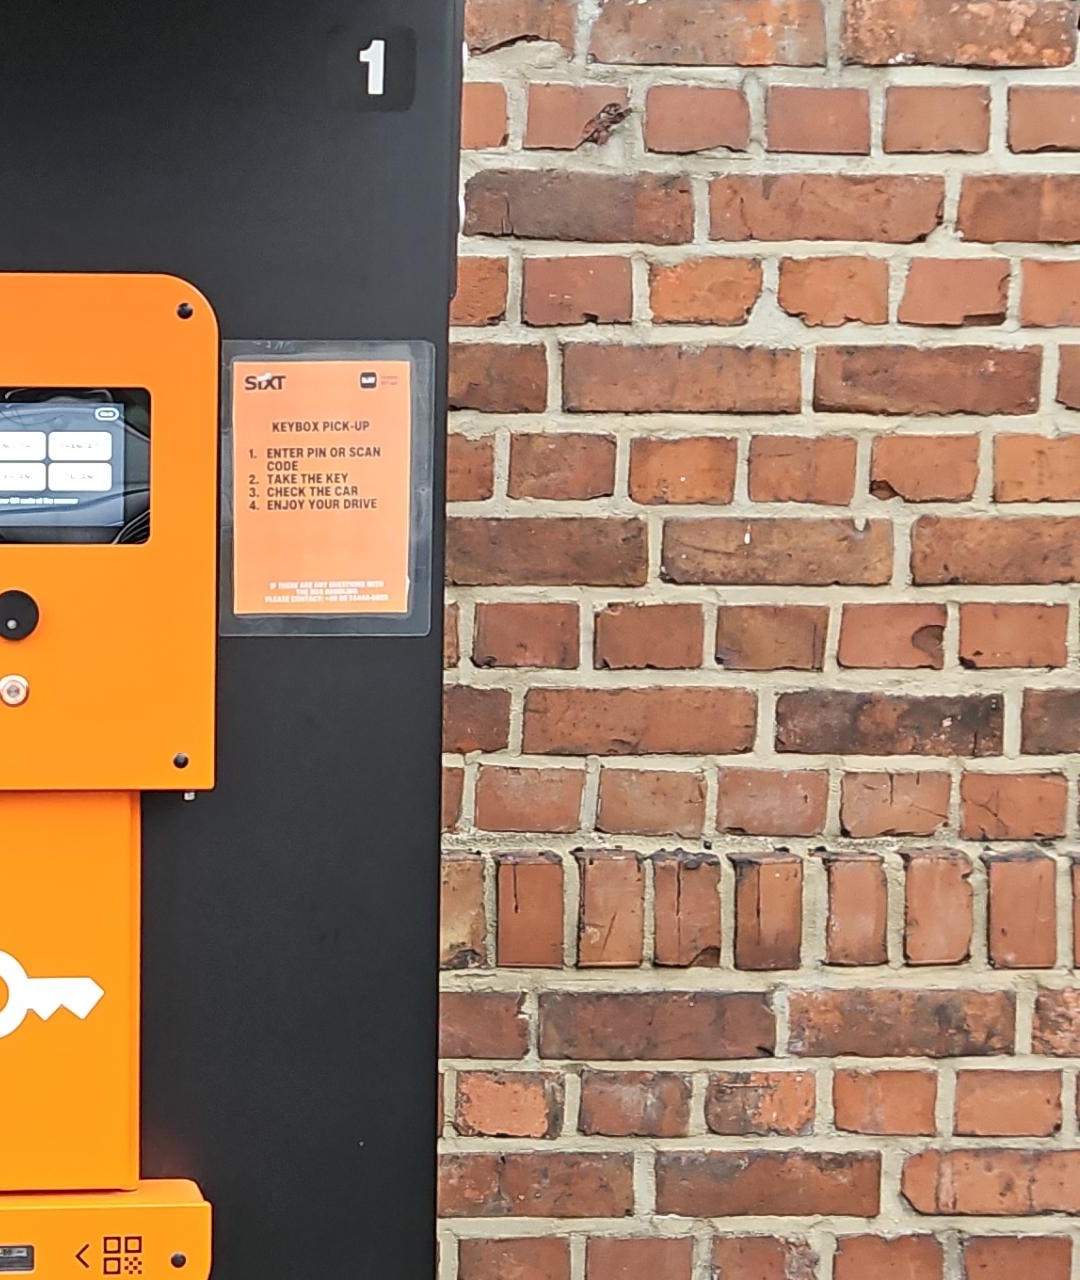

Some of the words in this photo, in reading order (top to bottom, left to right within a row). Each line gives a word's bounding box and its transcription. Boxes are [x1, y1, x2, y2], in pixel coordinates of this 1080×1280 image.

[359, 39, 385, 95] 1
[272, 421, 320, 433] KEYBOX
[323, 420, 370, 432] PICK-UP
[249, 448, 257, 459] 1.
[267, 447, 304, 459] ENTER
[307, 447, 327, 458] PIN
[330, 447, 346, 458] OR
[349, 446, 381, 458] SCAN
[266, 460, 299, 471] CODE
[248, 474, 259, 485] 2.
[267, 473, 298, 484] TAKE
[300, 473, 323, 484] THE
[325, 472, 348, 484] KEY
[248, 487, 260, 498] 3.
[266, 486, 306, 498] CHECK
[309, 486, 332, 497] THE
[334, 485, 358, 496] CAR
[249, 500, 260, 511] 4.
[267, 499, 305, 511] ENJOY
[308, 498, 340, 510] YOUR
[343, 498, 377, 510] DRIVE
